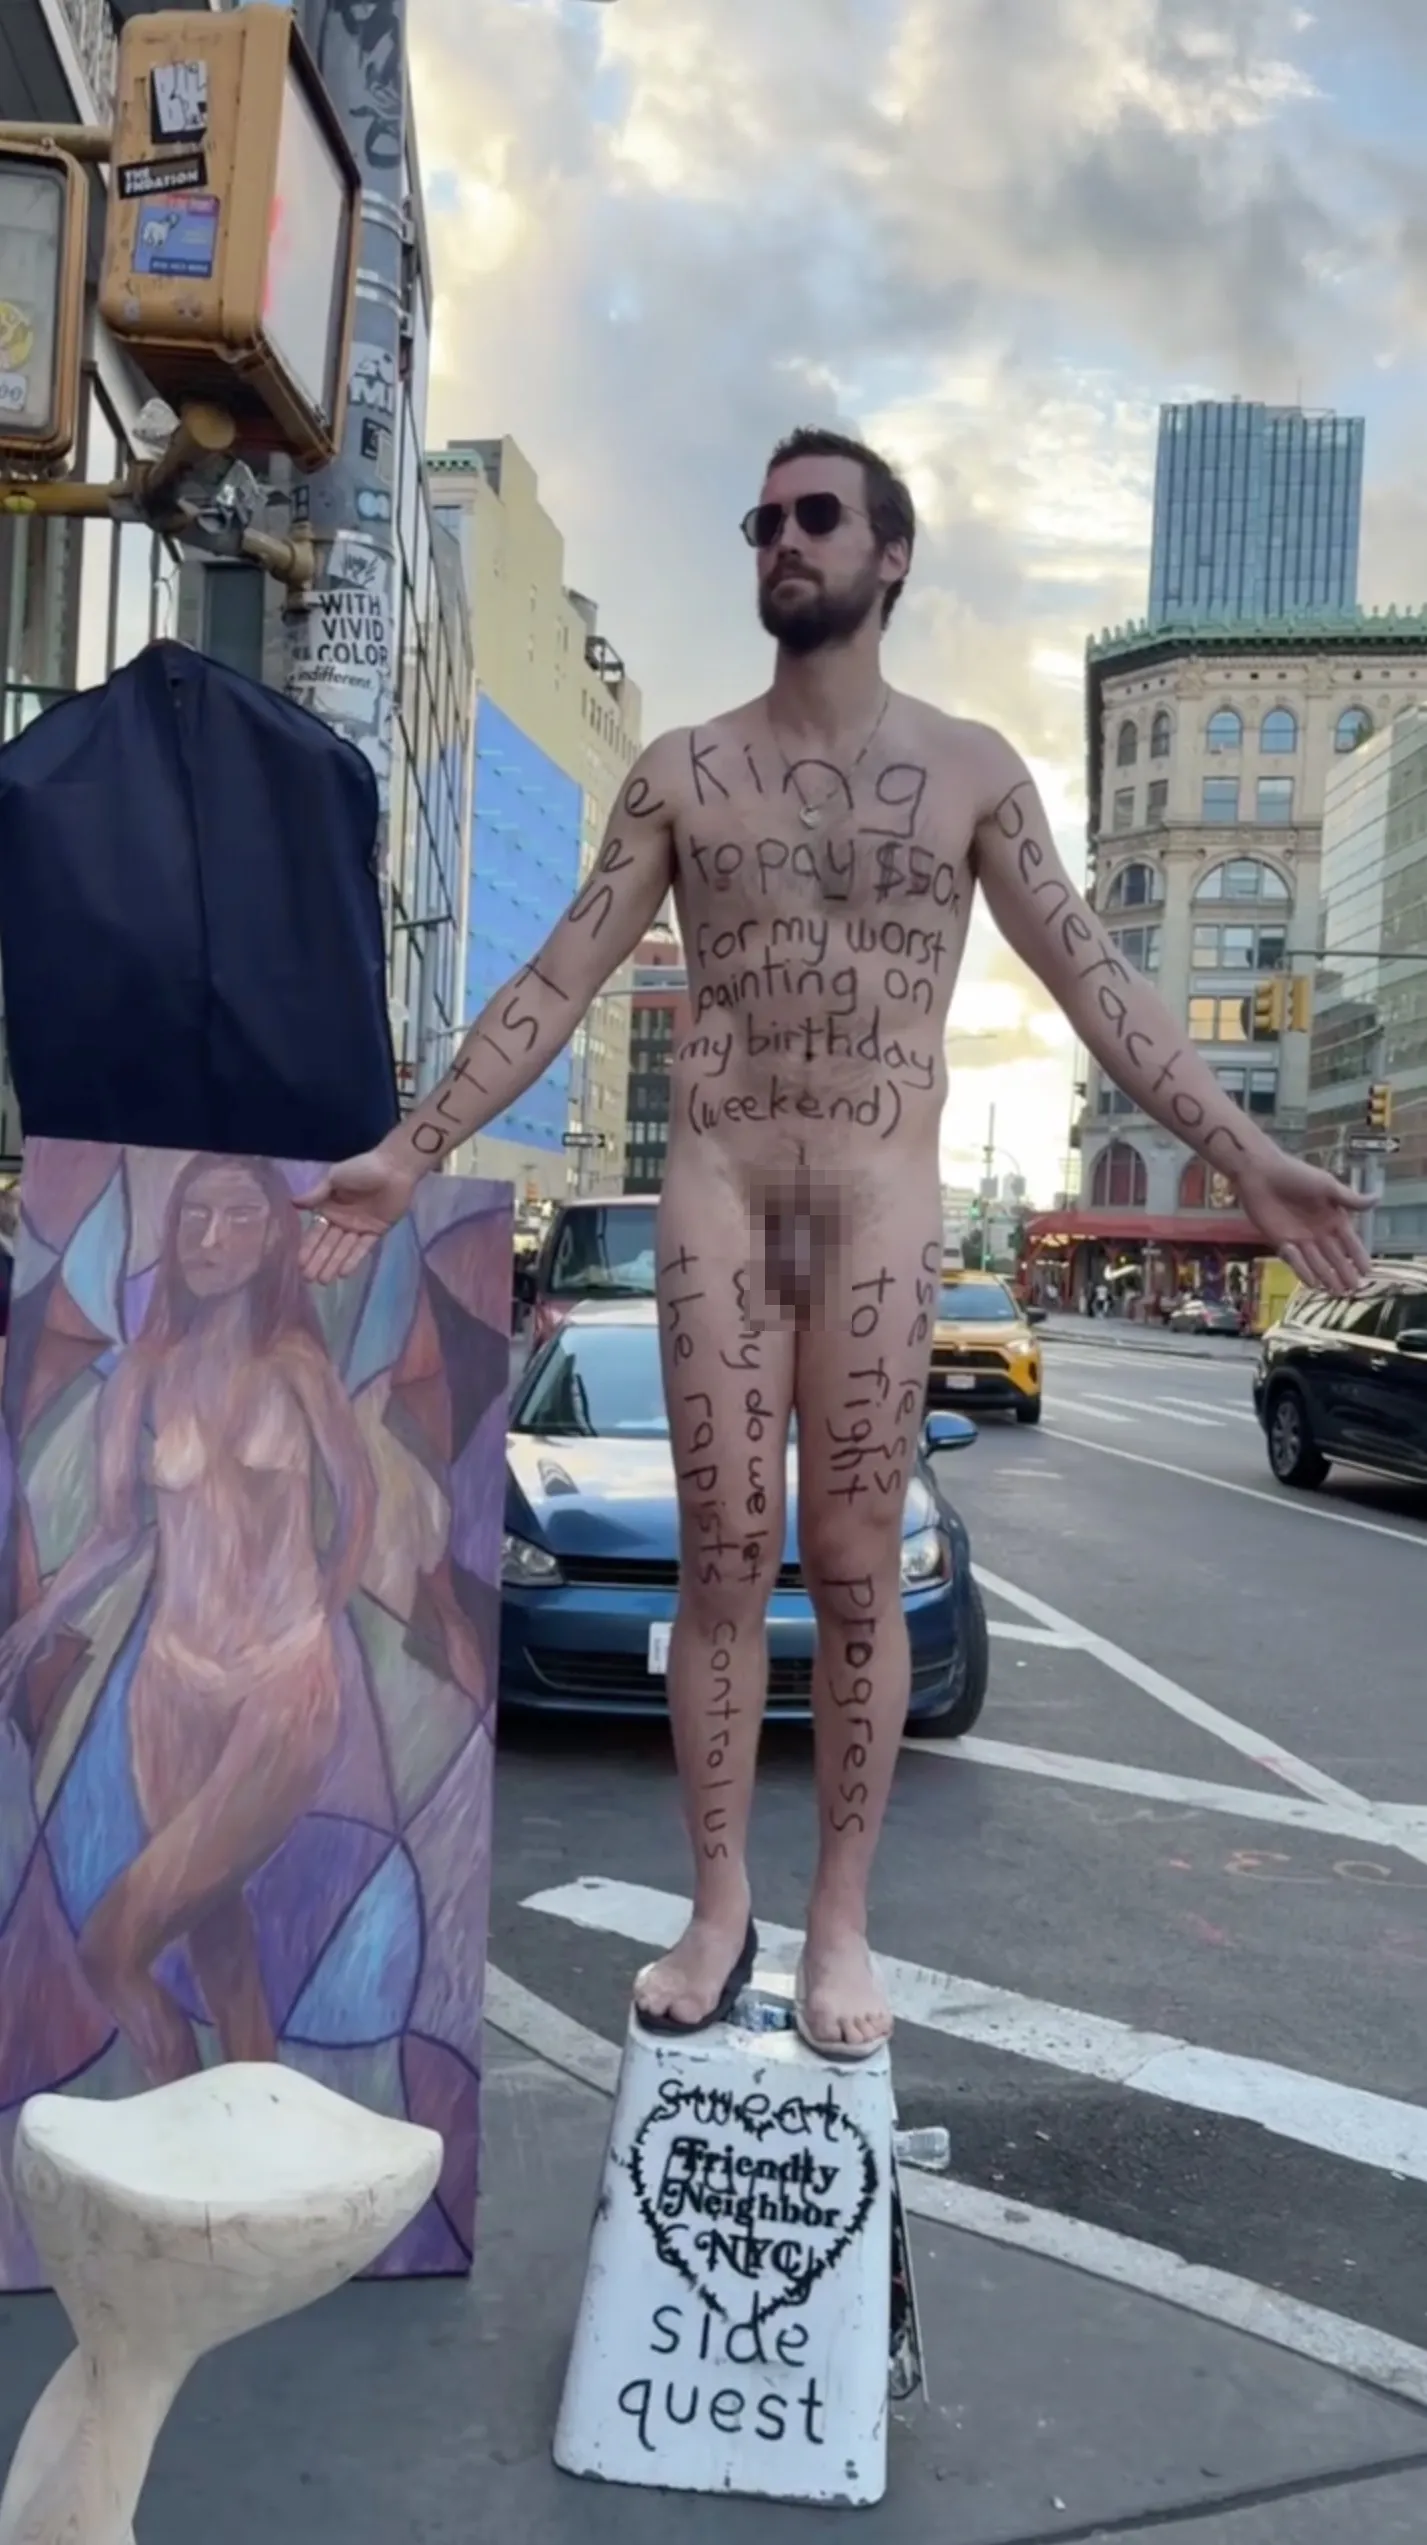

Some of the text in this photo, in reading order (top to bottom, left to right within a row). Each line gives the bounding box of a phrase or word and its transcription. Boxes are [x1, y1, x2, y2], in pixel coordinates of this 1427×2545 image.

[318, 592, 381, 616] WITH
[321, 617, 384, 642] VIVID
[317, 641, 388, 665] COLOR
[689, 834, 743, 876] to
[756, 837, 856, 900] pay
[697, 915, 947, 974] for my worst
[994, 780, 1246, 1152] benefactor
[694, 945, 934, 1024] painting on
[678, 1004, 935, 1090] my birthday
[688, 1075, 902, 1140] (weekend)
[821, 1265, 897, 1834] to fight progress
[701, 1619, 743, 1790] control
[702, 1807, 730, 1860] us
[669, 2135, 841, 2196] Friendly
[661, 2178, 842, 2228] Neighbor
[693, 2228, 804, 2280] NYC
[649, 2290, 810, 2368] side
[617, 2376, 825, 2452] quest
